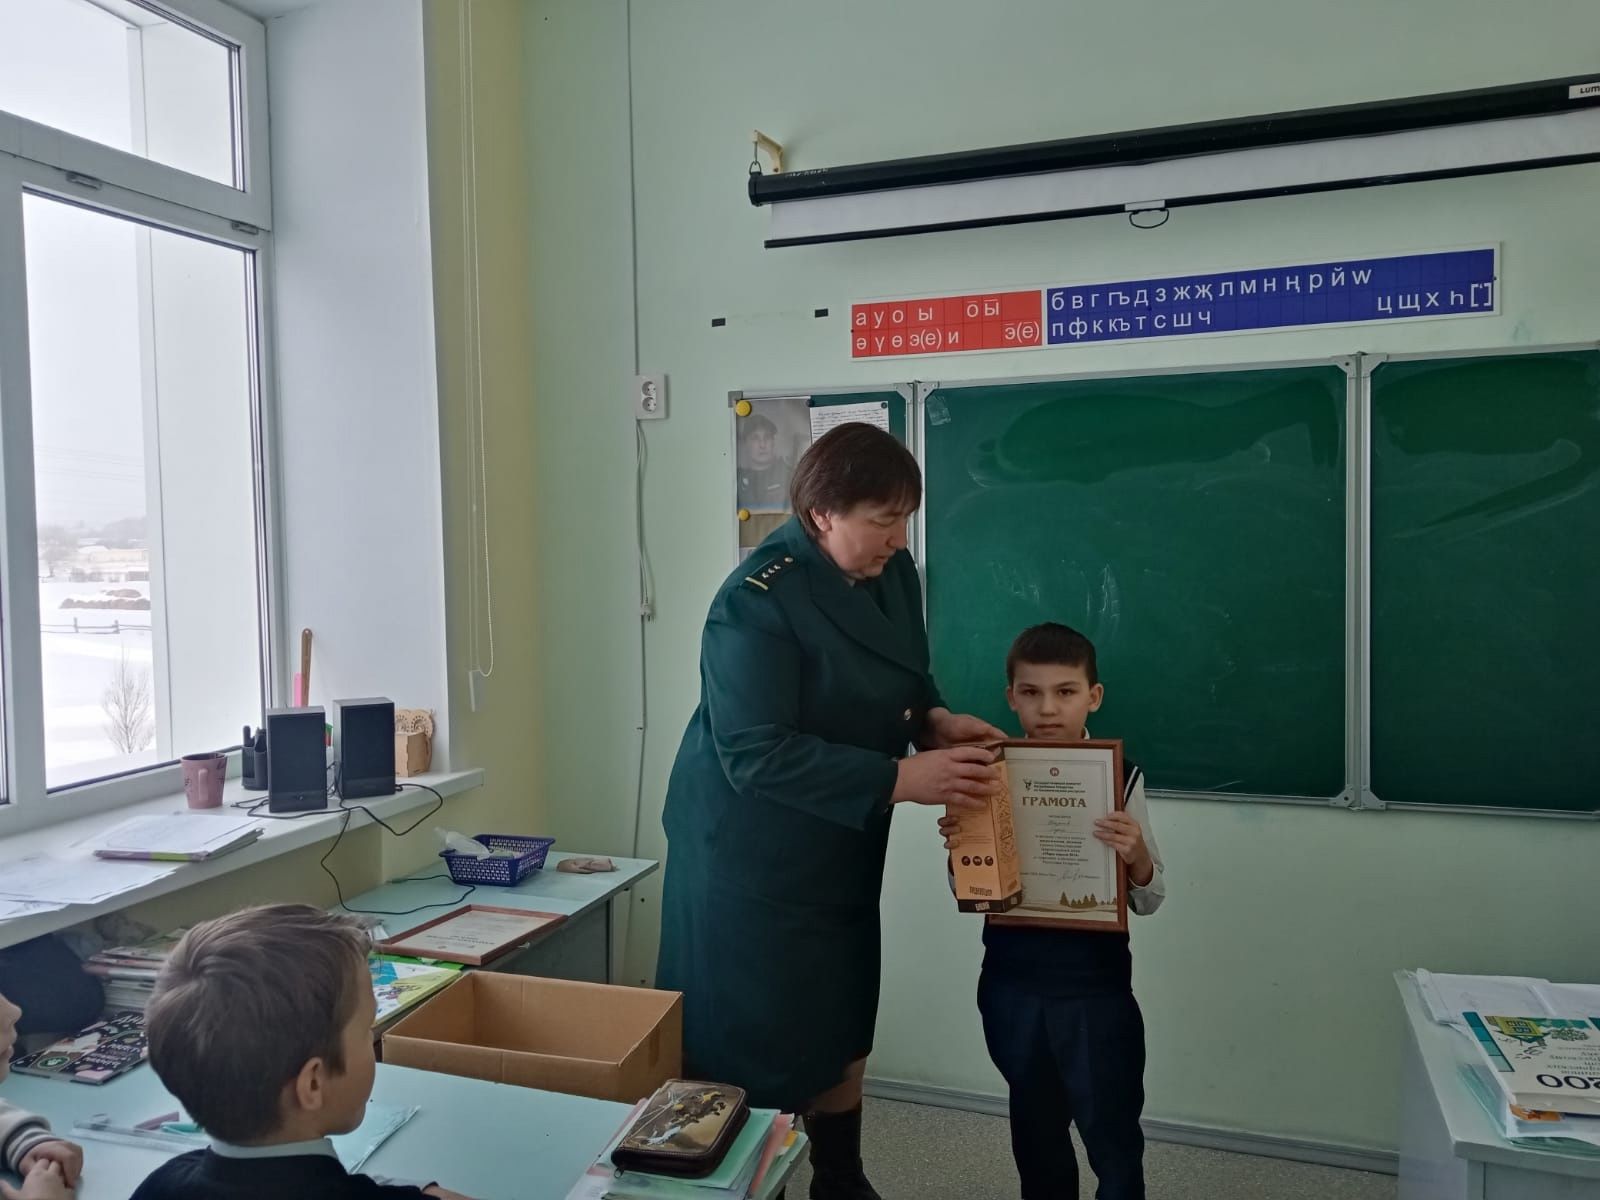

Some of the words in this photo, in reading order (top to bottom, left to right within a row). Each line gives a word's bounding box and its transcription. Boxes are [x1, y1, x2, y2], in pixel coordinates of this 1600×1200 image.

[1051, 291, 1065, 311] б
[1072, 295, 1083, 309] в
[1091, 293, 1100, 308] г
[1133, 289, 1149, 307] д
[1155, 287, 1166, 302] з
[1173, 285, 1191, 301] ж
[1218, 281, 1233, 297] л
[1240, 279, 1256, 295] м
[1263, 277, 1276, 292] н
[1309, 273, 1323, 293] р
[1331, 266, 1345, 287] й
[855, 312, 867, 326] а
[873, 311, 884, 329] у
[892, 309, 904, 323] о
[918, 307, 933, 321] ы
[1052, 322, 1064, 337] п
[1068, 316, 1088, 340] ф
[1093, 319, 1103, 334] к
[1135, 316, 1147, 330] т
[1154, 314, 1166, 329] с
[1173, 312, 1192, 328] ш
[1198, 310, 1211, 325] ч
[1377, 295, 1393, 314] ц
[1398, 293, 1421, 312] щ
[1425, 291, 1439, 308] х
[856, 337, 867, 350] ә
[891, 335, 903, 348] ө
[948, 331, 959, 344] и
[1022, 796, 1087, 808] ГРАМОТА
